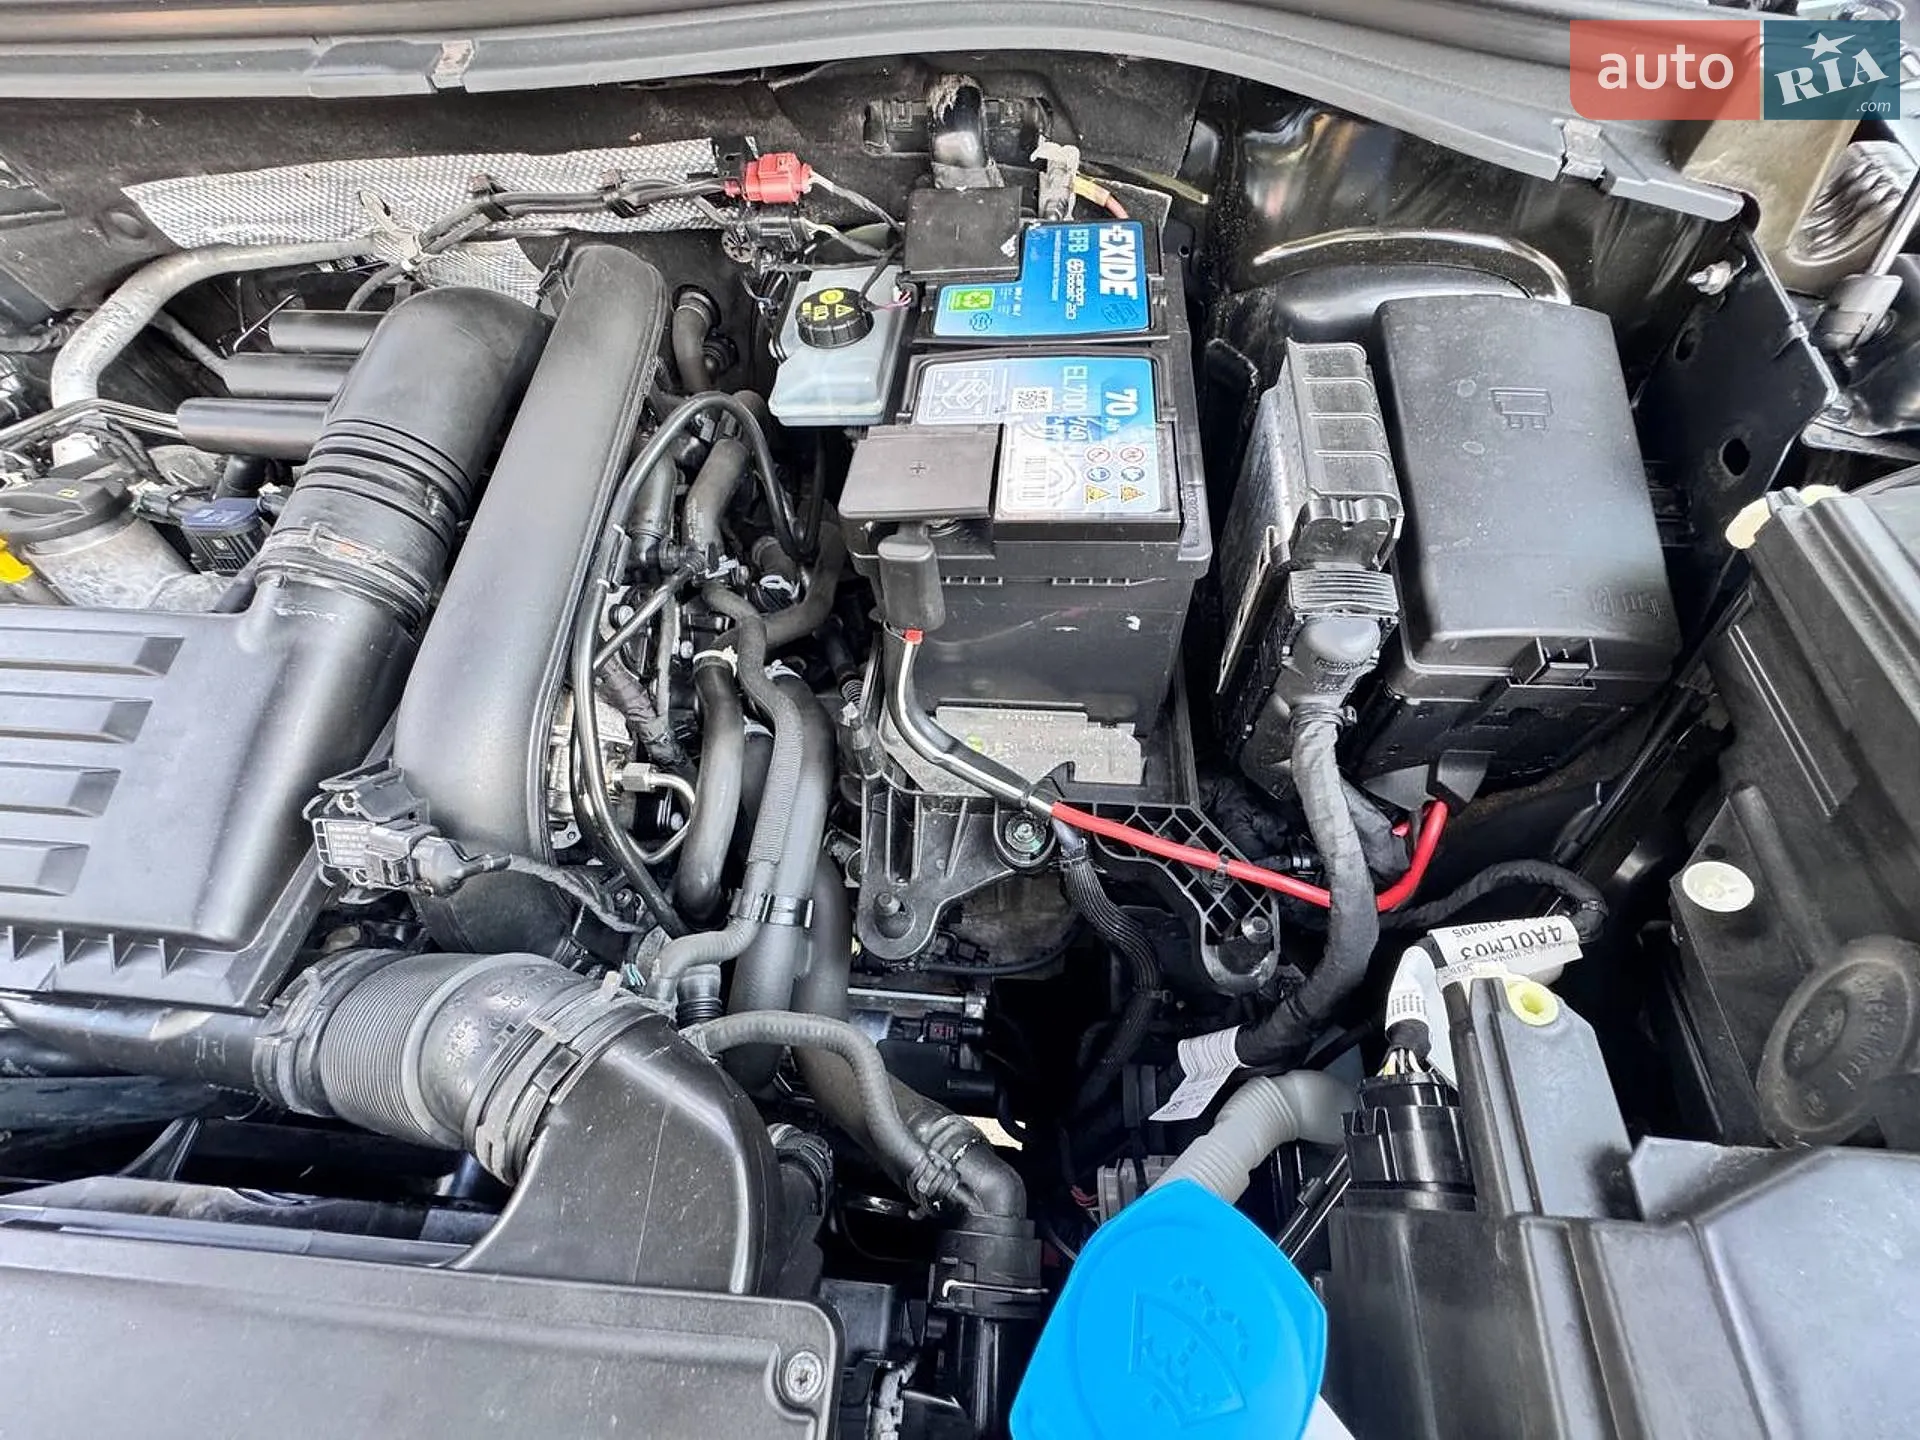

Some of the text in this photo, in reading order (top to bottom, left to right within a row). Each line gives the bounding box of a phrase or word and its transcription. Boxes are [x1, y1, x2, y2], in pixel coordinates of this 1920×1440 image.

[1068, 228, 1089, 252] EFB
[1099, 227, 1137, 297] EXIDE
[1063, 365, 1088, 412] EL700
[1105, 388, 1138, 416] 70
